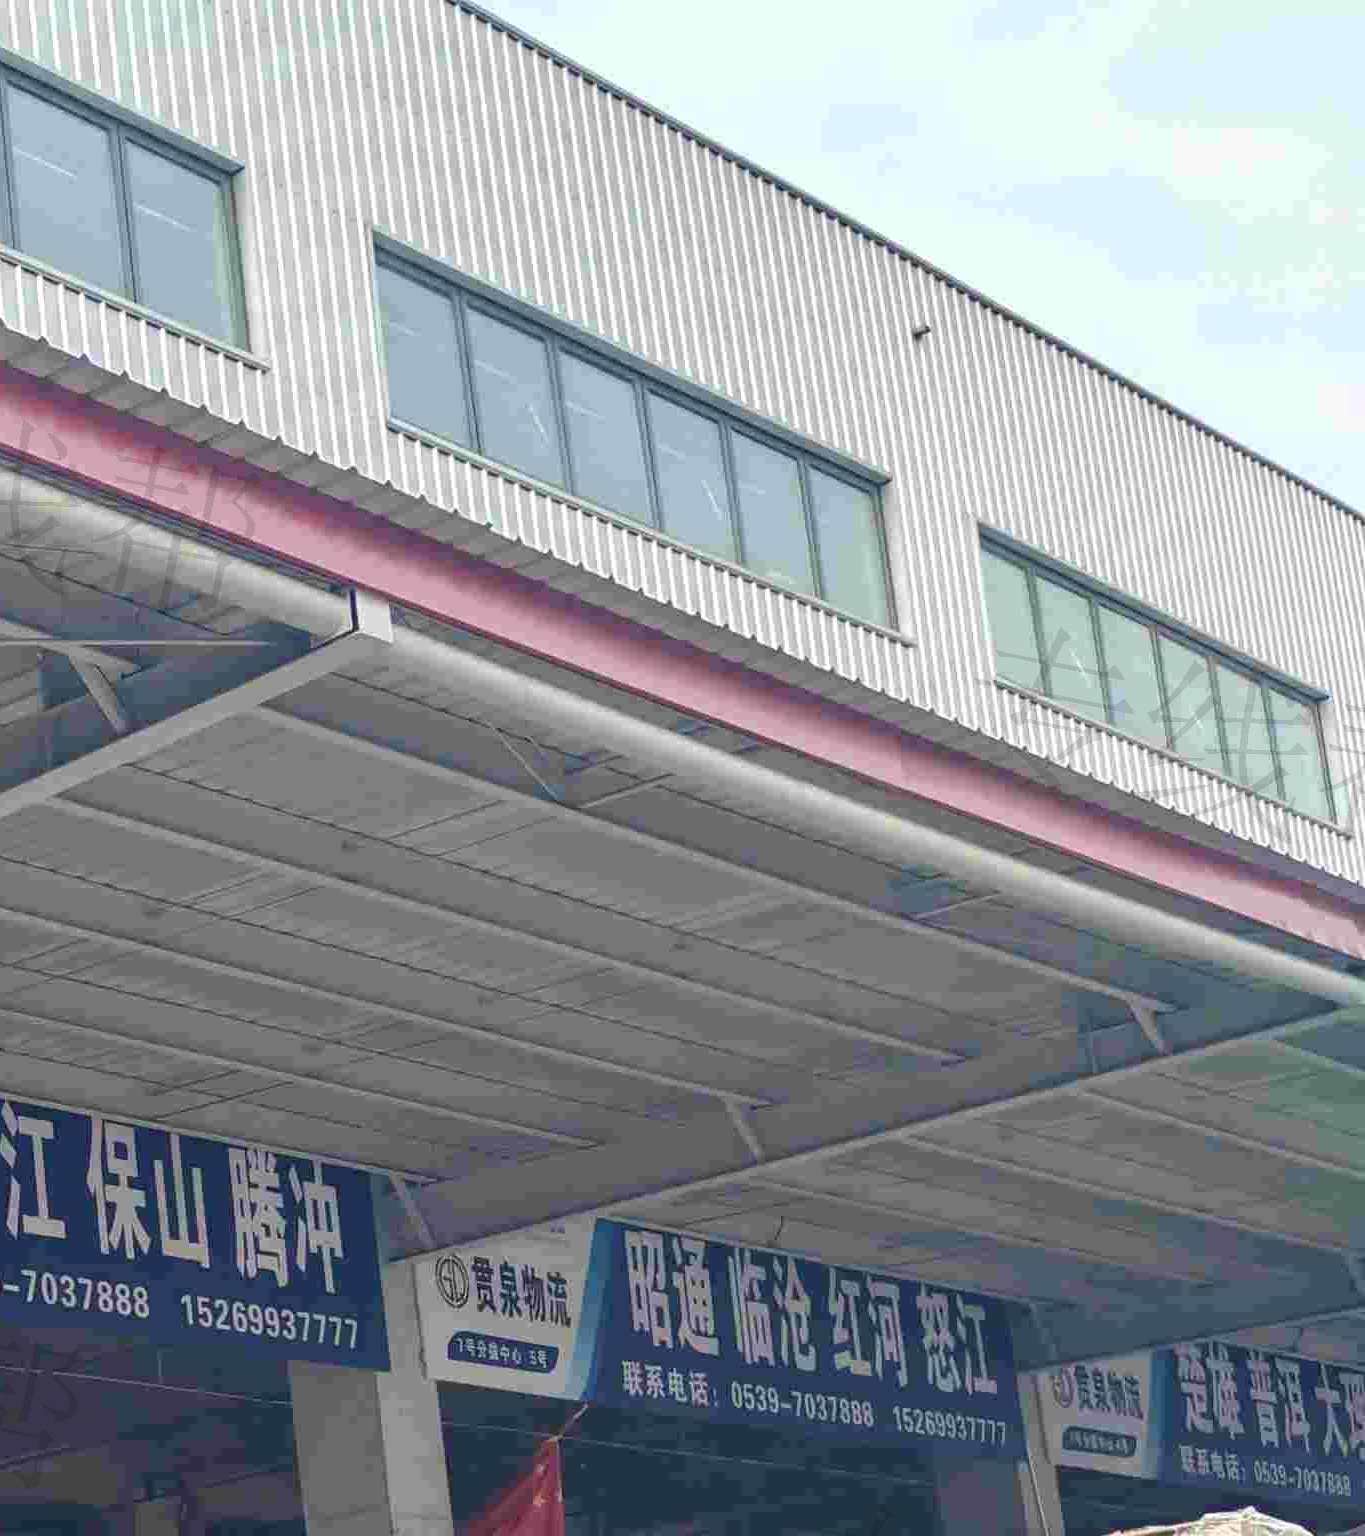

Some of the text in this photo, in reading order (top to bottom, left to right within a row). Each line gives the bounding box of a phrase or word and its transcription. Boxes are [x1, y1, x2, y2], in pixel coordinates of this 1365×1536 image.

[85, 1115, 211, 1269] 保山
[226, 1145, 346, 1296] 腾冲
[180, 1293, 360, 1350] 15269937777
[471, 1255, 571, 1328] 贯泉物流
[623, 1229, 999, 1395] 昭通 临沧 红河 怒江
[730, 1381, 875, 1428] 0539-7037888
[893, 1405, 1007, 1446] 15269937777
